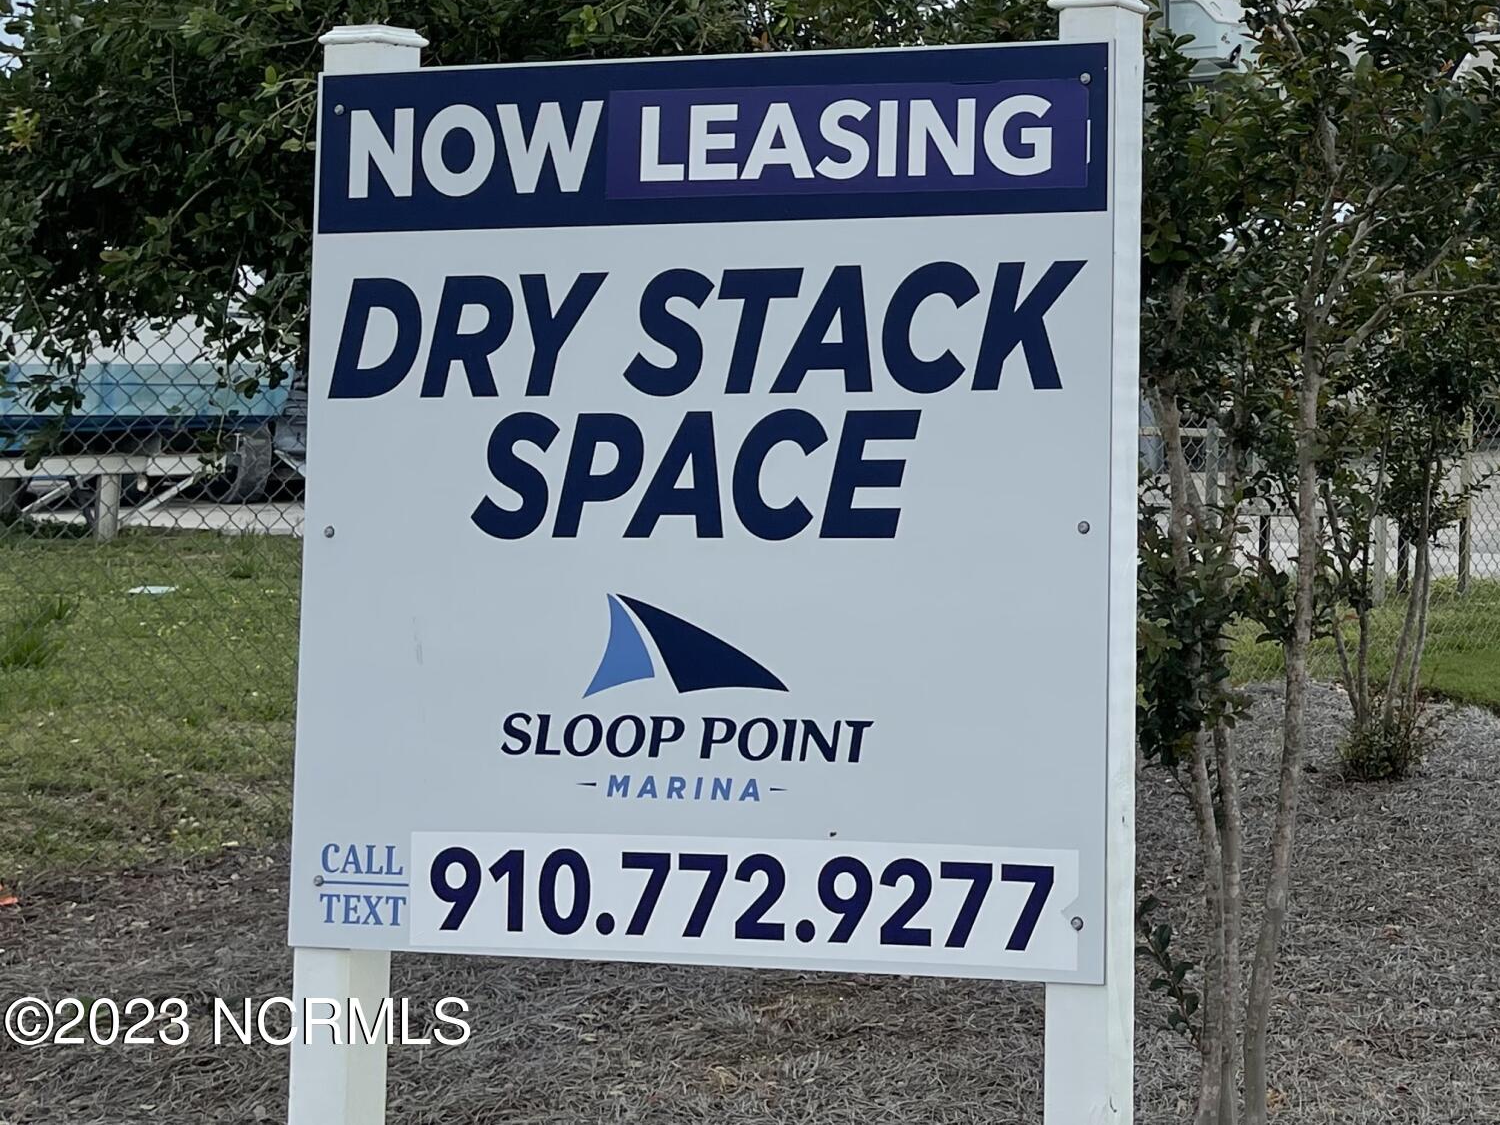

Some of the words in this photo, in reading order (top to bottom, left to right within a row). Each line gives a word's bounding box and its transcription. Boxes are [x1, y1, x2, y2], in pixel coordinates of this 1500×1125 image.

[348, 100, 605, 199] NOW
[639, 94, 1054, 182] LEASING
[327, 271, 609, 400] DRY
[622, 259, 1089, 398] STACK
[470, 408, 923, 541] SPACE
[500, 712, 686, 758] SLOOP
[698, 717, 876, 763] POINT
[606, 774, 762, 802] MARINA
[321, 843, 404, 876] CALL
[319, 893, 407, 927] TEXT
[430, 846, 1055, 952] 910.772.9277
